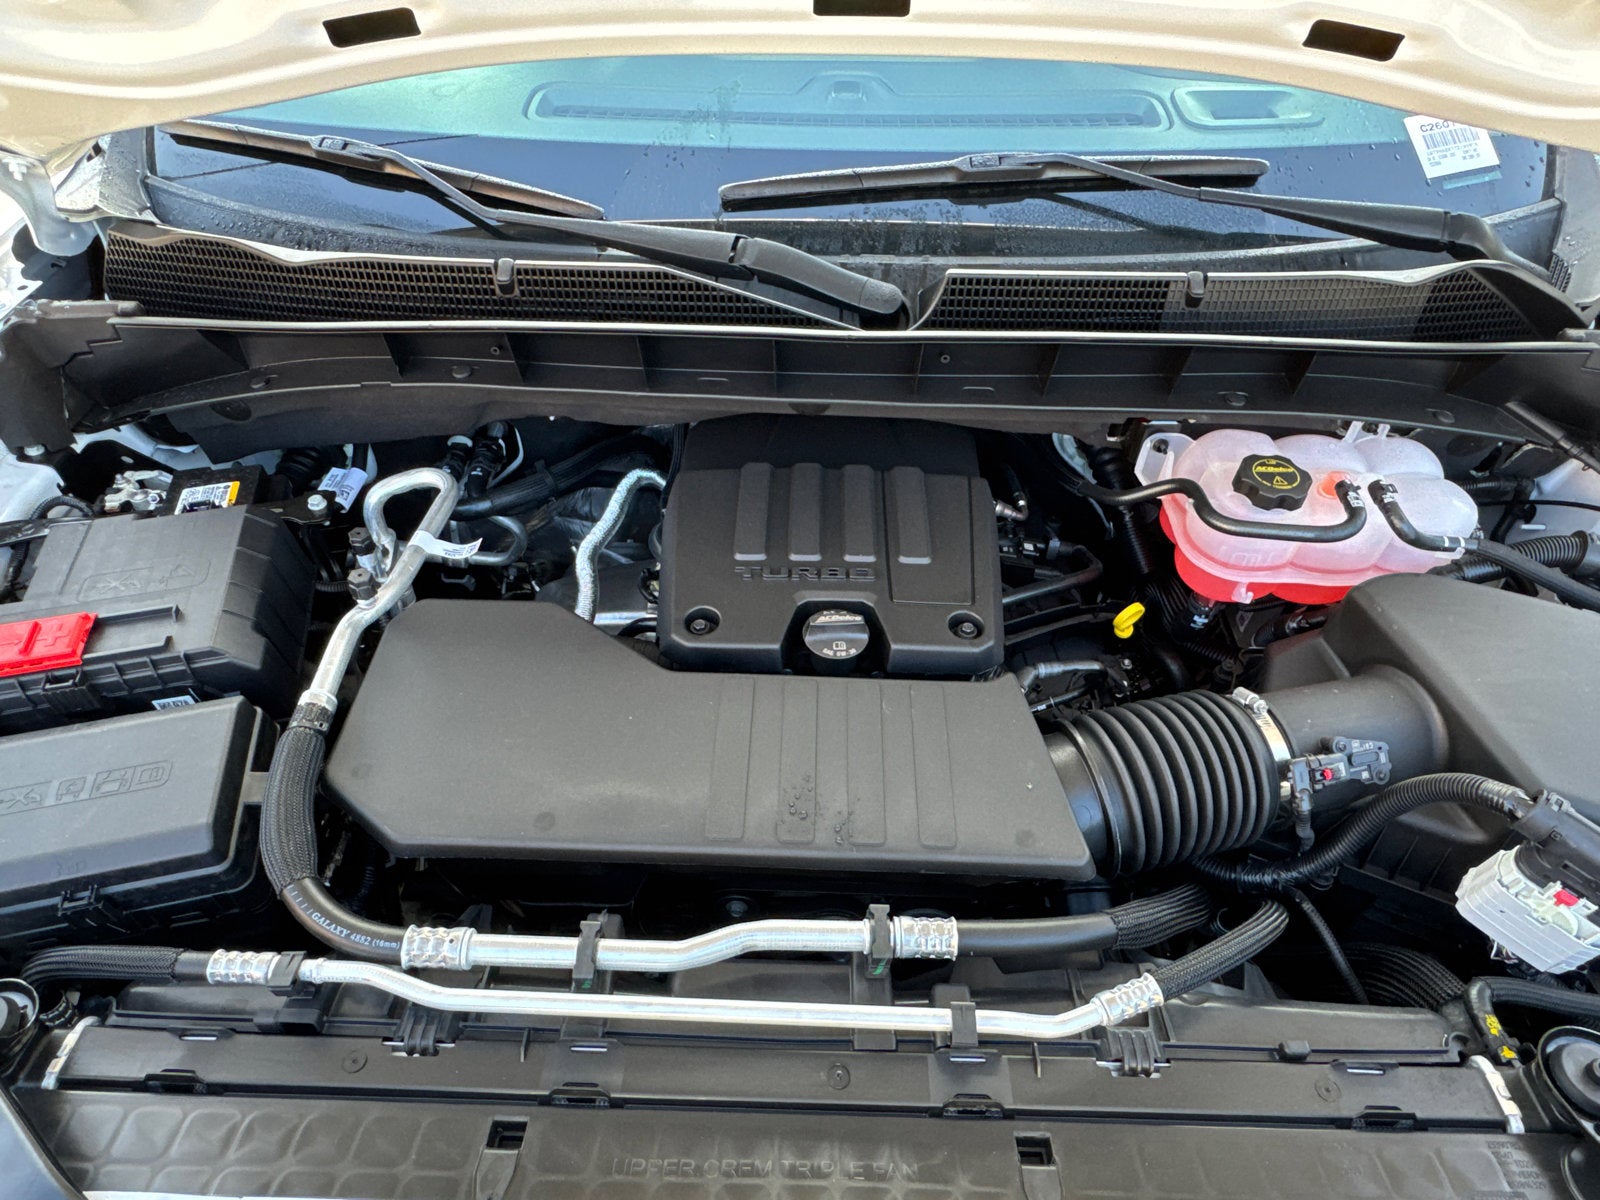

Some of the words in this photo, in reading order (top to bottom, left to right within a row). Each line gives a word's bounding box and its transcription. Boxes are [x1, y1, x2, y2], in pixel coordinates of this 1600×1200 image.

[734, 566, 876, 582] TURBO
[814, 614, 862, 623] ACDelco
[311, 912, 351, 938] GALAXY
[350, 932, 371, 946] 4882
[372, 938, 401, 950] (16mm)
[611, 1157, 696, 1179] UPPER
[873, 1161, 919, 1181] FAN
